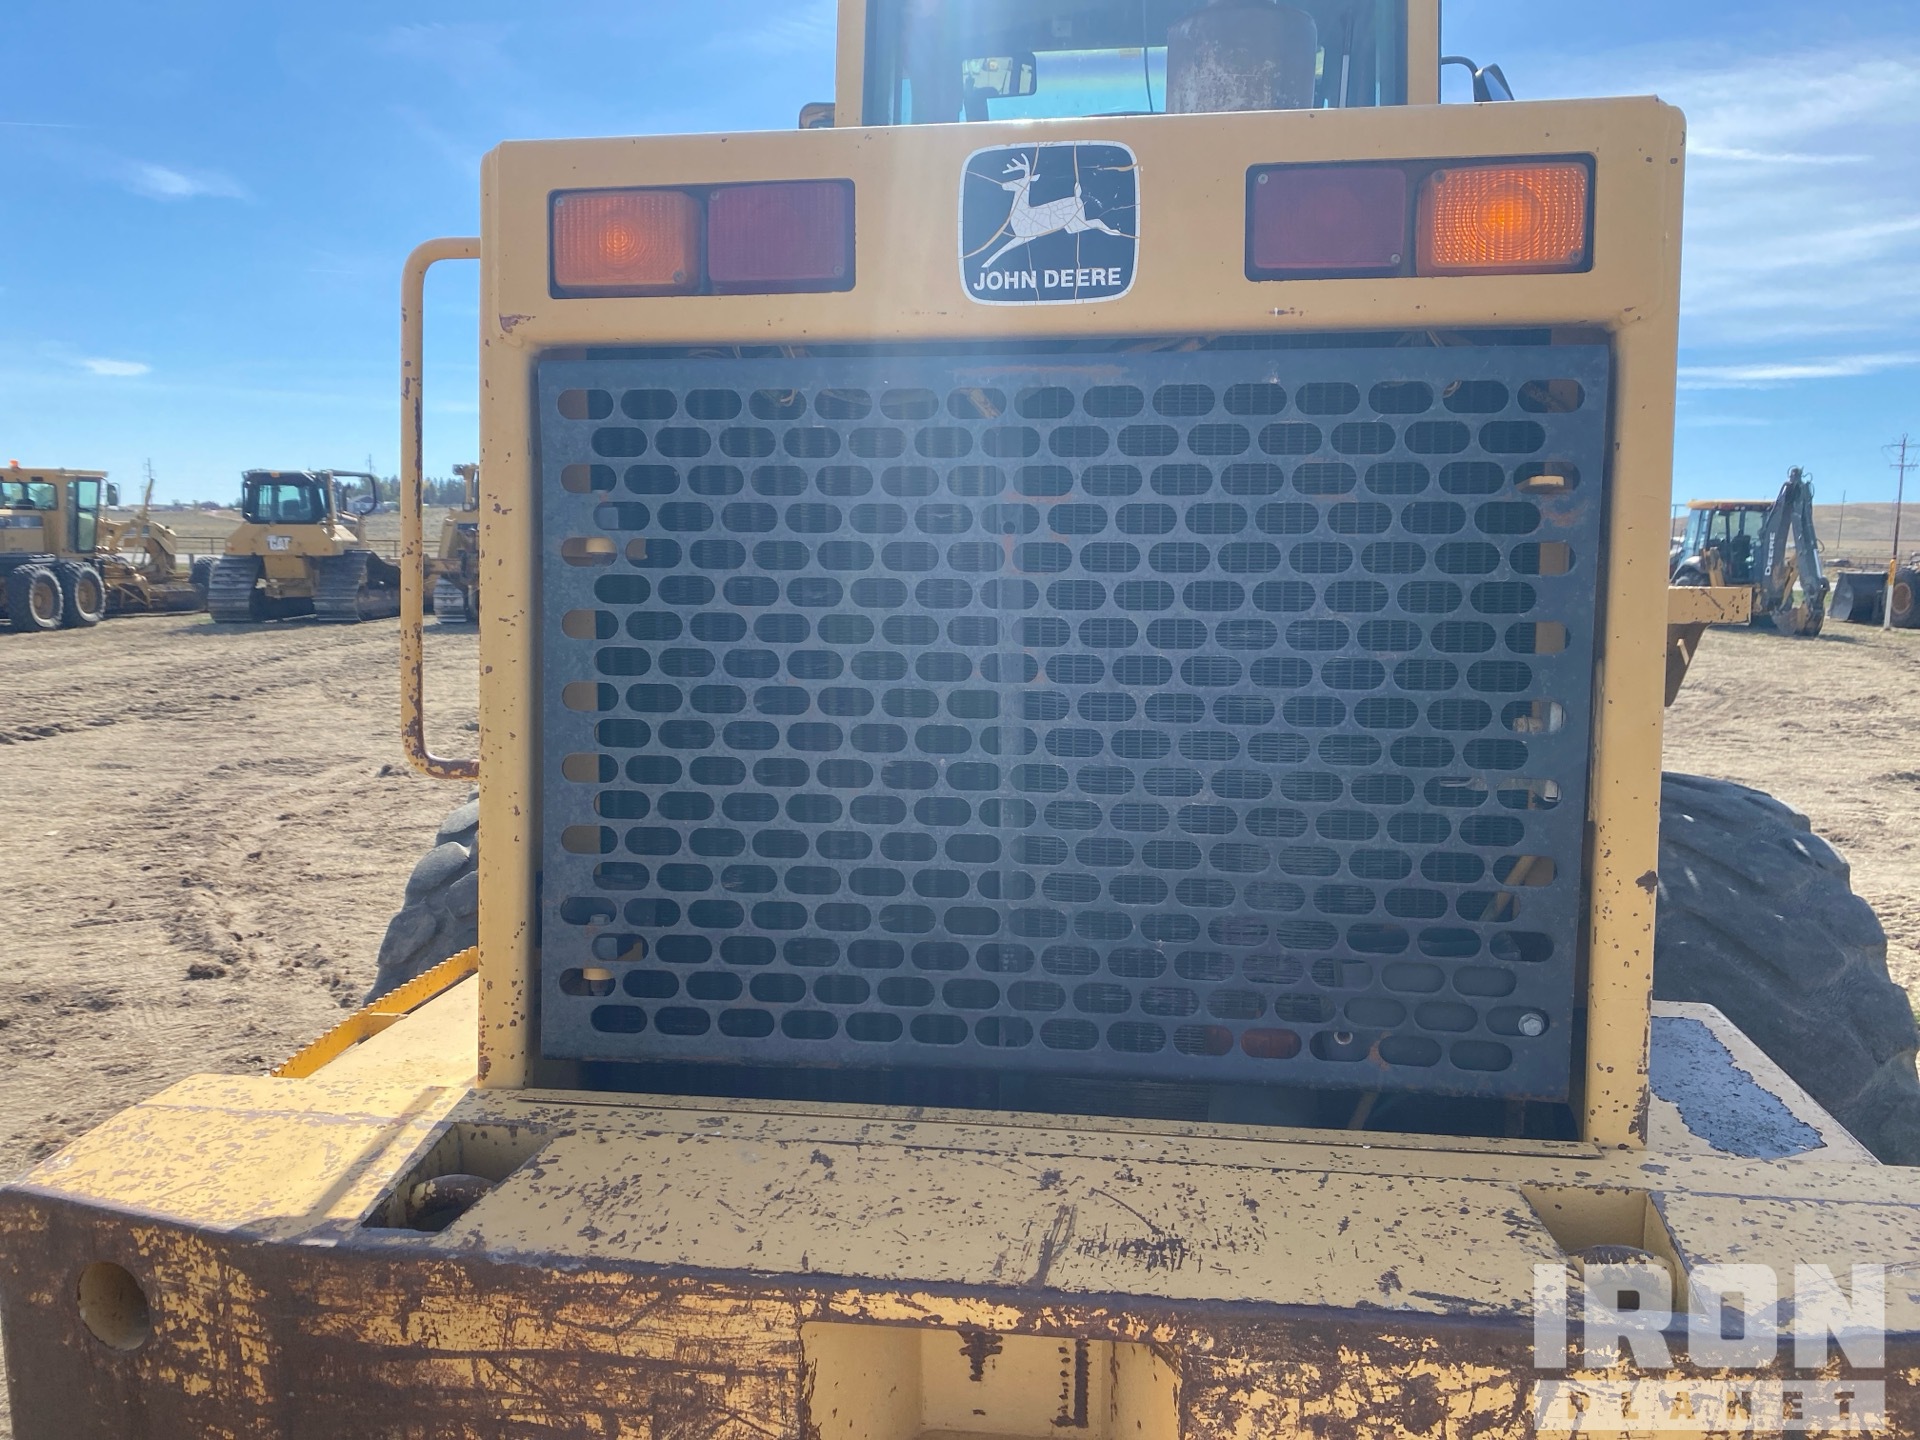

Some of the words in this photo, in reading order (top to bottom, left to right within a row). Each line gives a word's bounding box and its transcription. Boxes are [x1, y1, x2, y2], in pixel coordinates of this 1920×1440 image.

[973, 270, 1037, 291] JOHN
[1044, 267, 1122, 288] DEERE
[266, 535, 292, 551] CAT
[1764, 531, 1776, 576] DEERE
